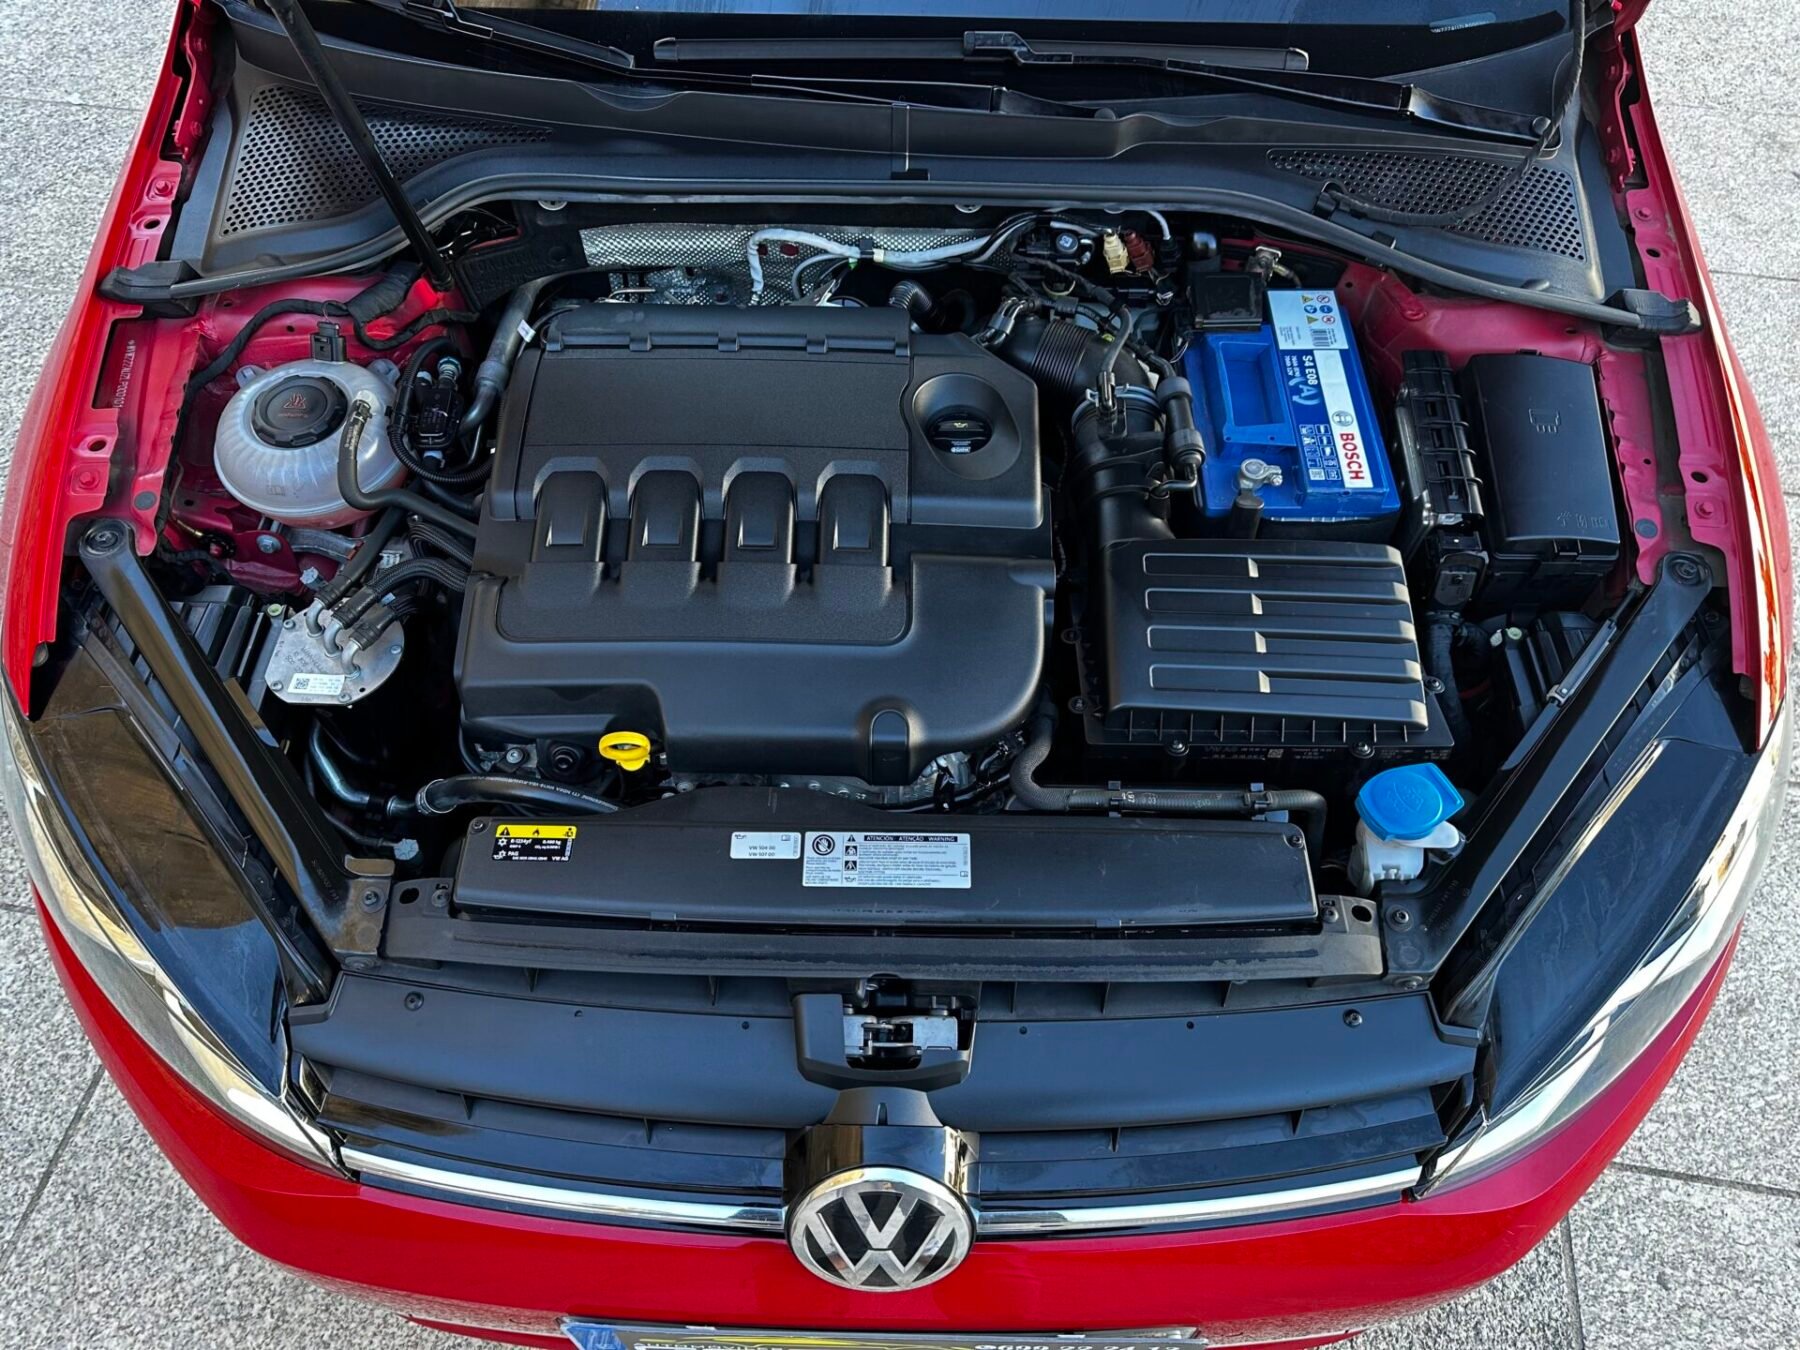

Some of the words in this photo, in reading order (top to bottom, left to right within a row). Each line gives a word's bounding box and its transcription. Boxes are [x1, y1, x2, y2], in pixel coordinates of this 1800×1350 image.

[1302, 355, 1314, 367] S4
[1305, 368, 1318, 385] E08
[1340, 432, 1365, 480] BOSCH
